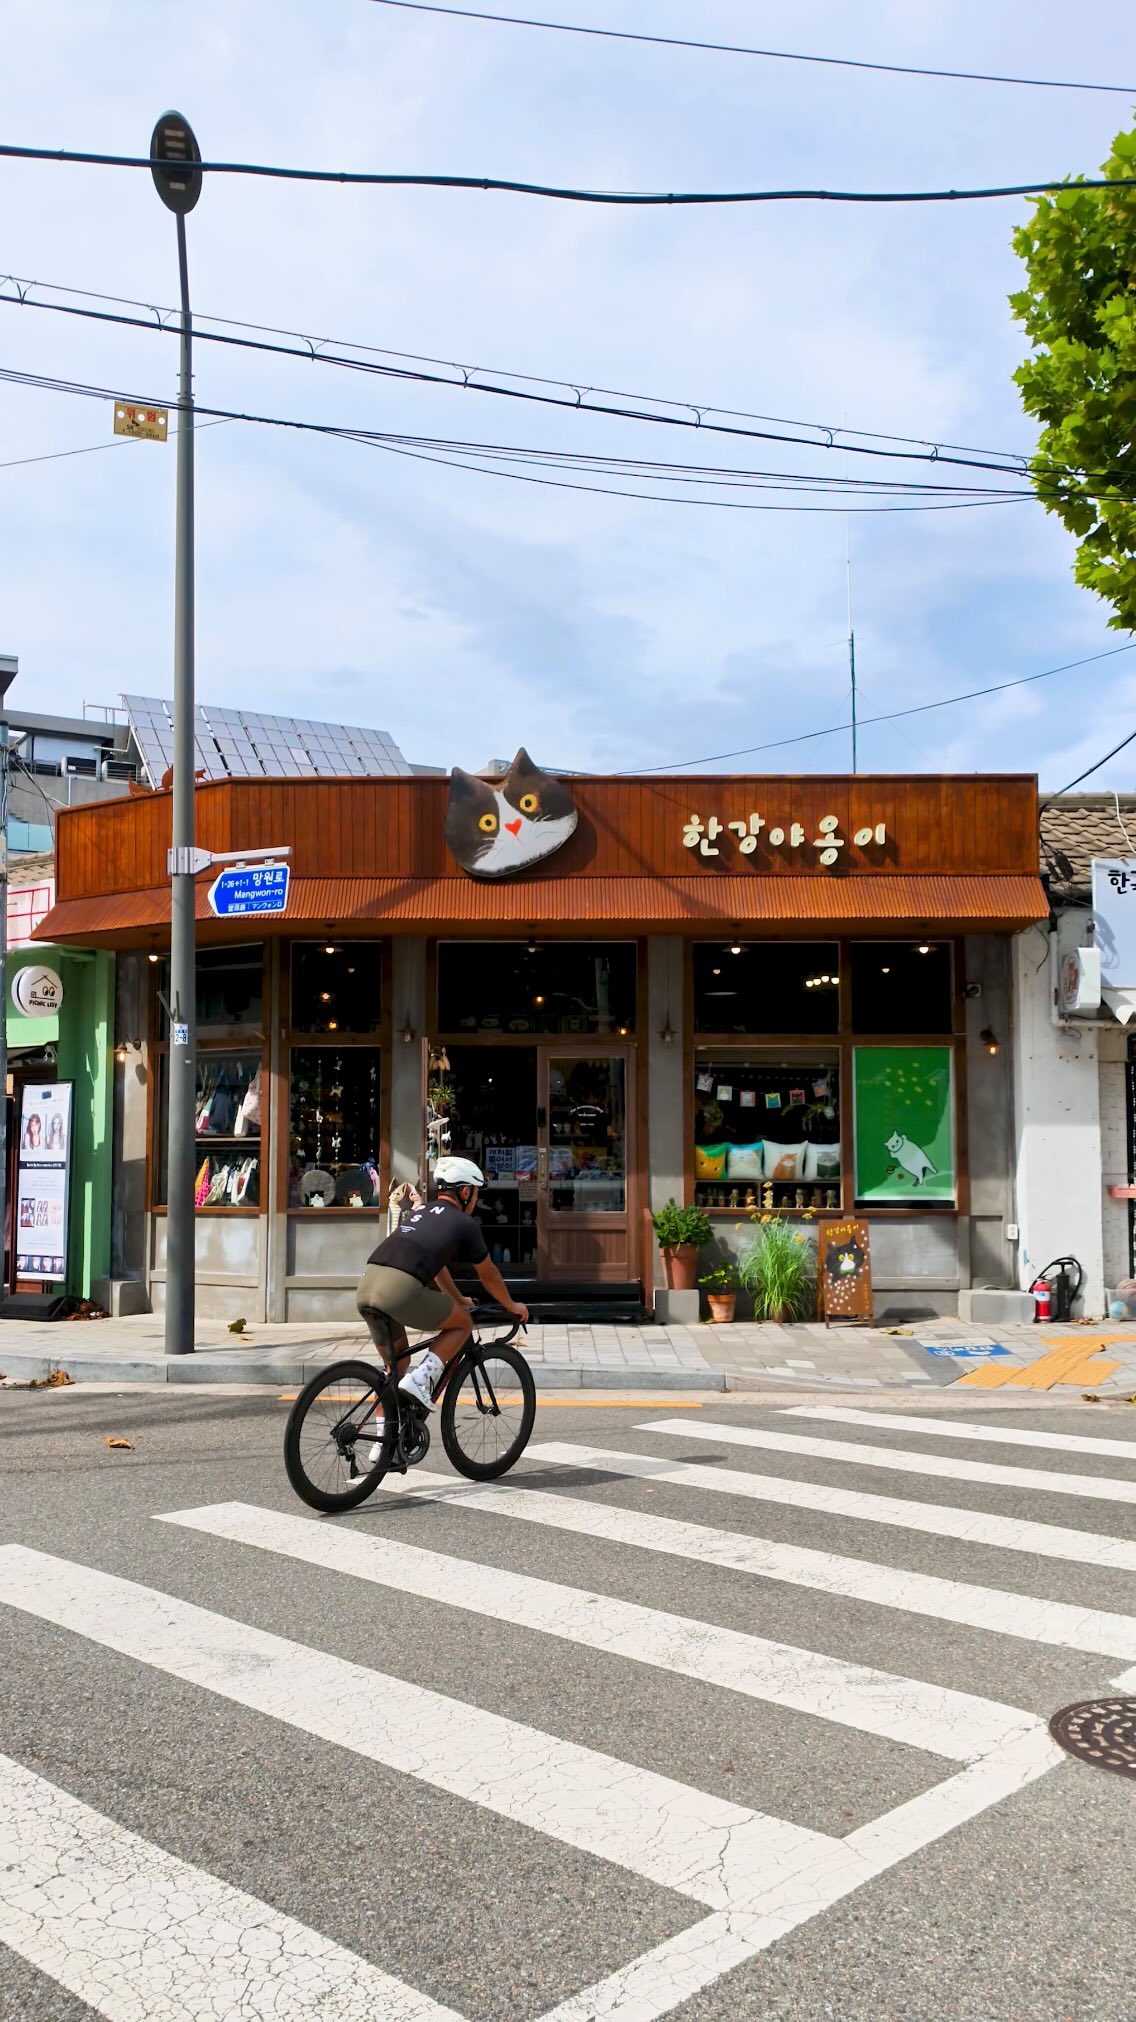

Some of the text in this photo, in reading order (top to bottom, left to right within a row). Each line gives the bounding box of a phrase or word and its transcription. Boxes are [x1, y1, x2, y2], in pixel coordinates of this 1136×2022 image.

[252, 871, 285, 887] 망원로
[234, 888, 284, 900] Mangwon-ro
[429, 1206, 446, 1215] N
[410, 1214, 423, 1223] S
